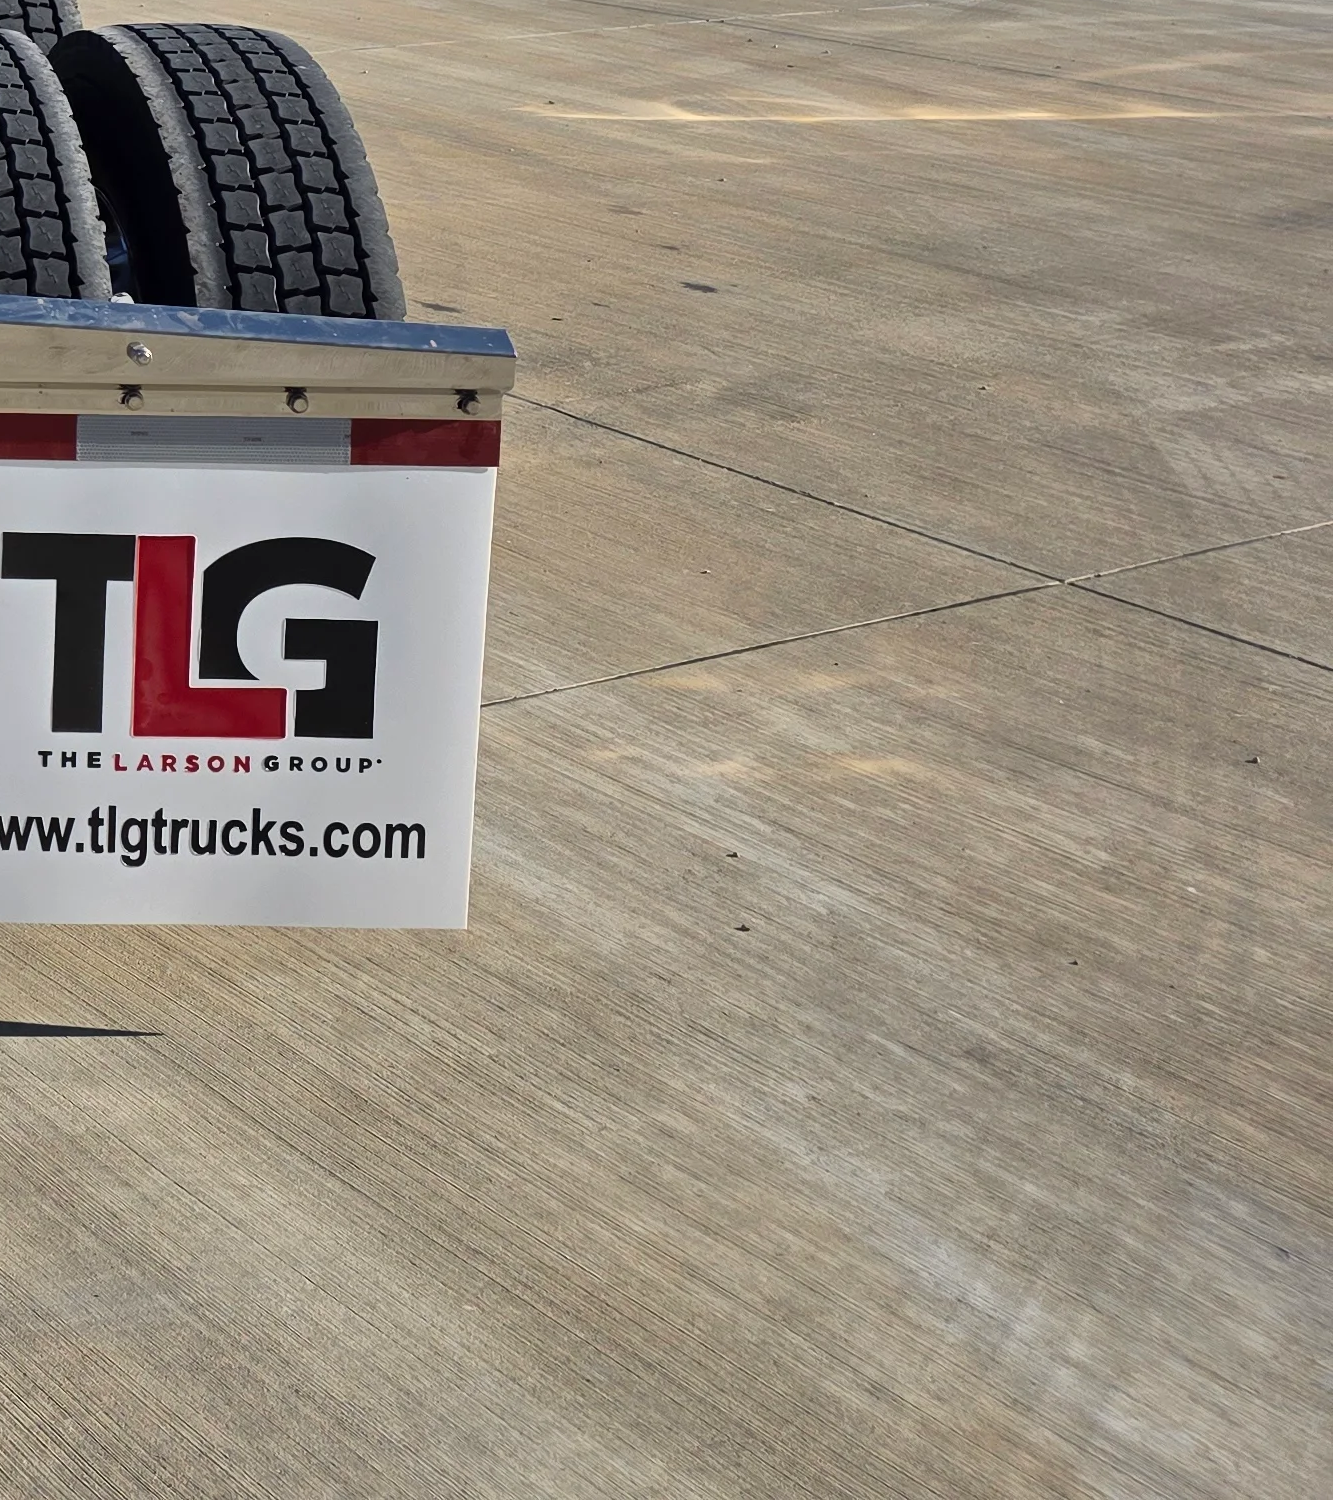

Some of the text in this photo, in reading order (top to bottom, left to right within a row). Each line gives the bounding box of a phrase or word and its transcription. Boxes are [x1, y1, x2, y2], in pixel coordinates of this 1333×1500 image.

[0, 531, 379, 740] TLG
[37, 750, 102, 769] THE
[114, 753, 251, 773] LARSON
